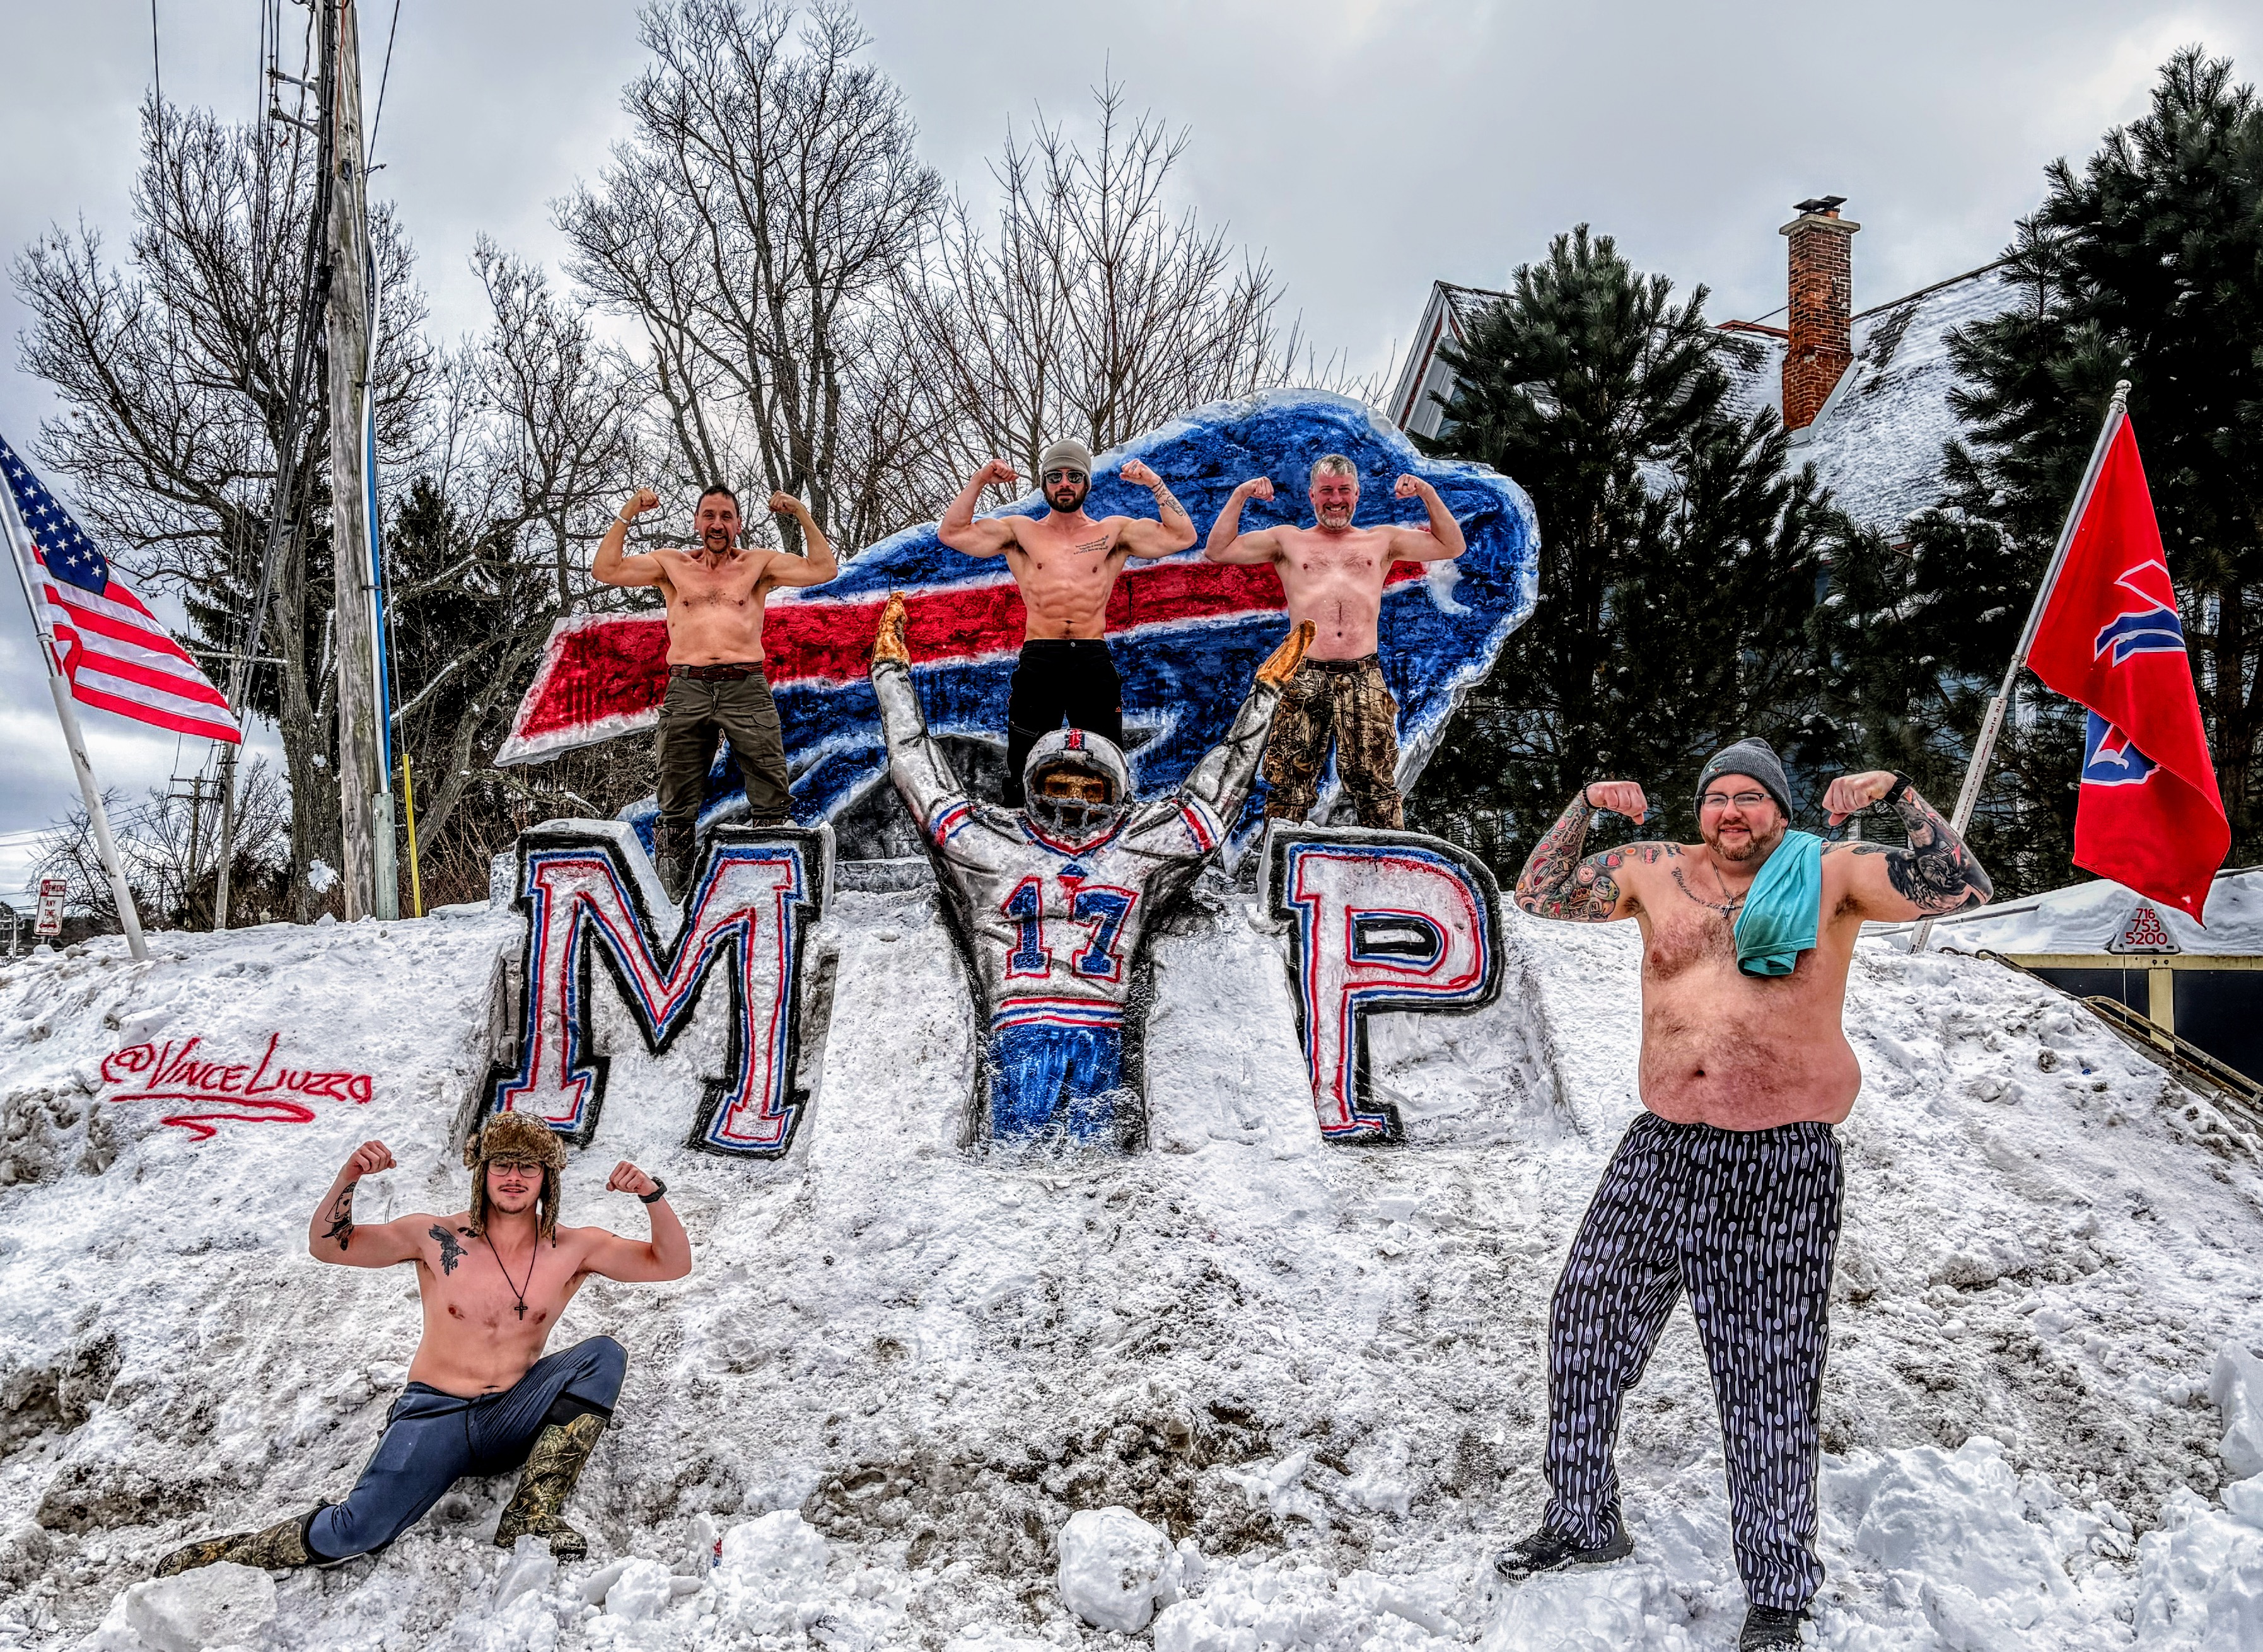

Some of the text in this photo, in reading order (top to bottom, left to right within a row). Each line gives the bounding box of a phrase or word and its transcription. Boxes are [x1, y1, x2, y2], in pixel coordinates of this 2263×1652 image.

[2136, 908, 2155, 919] 716
[1001, 875, 1140, 983] 17
[2131, 919, 2160, 933] 753
[2125, 932, 2168, 945] 5200
